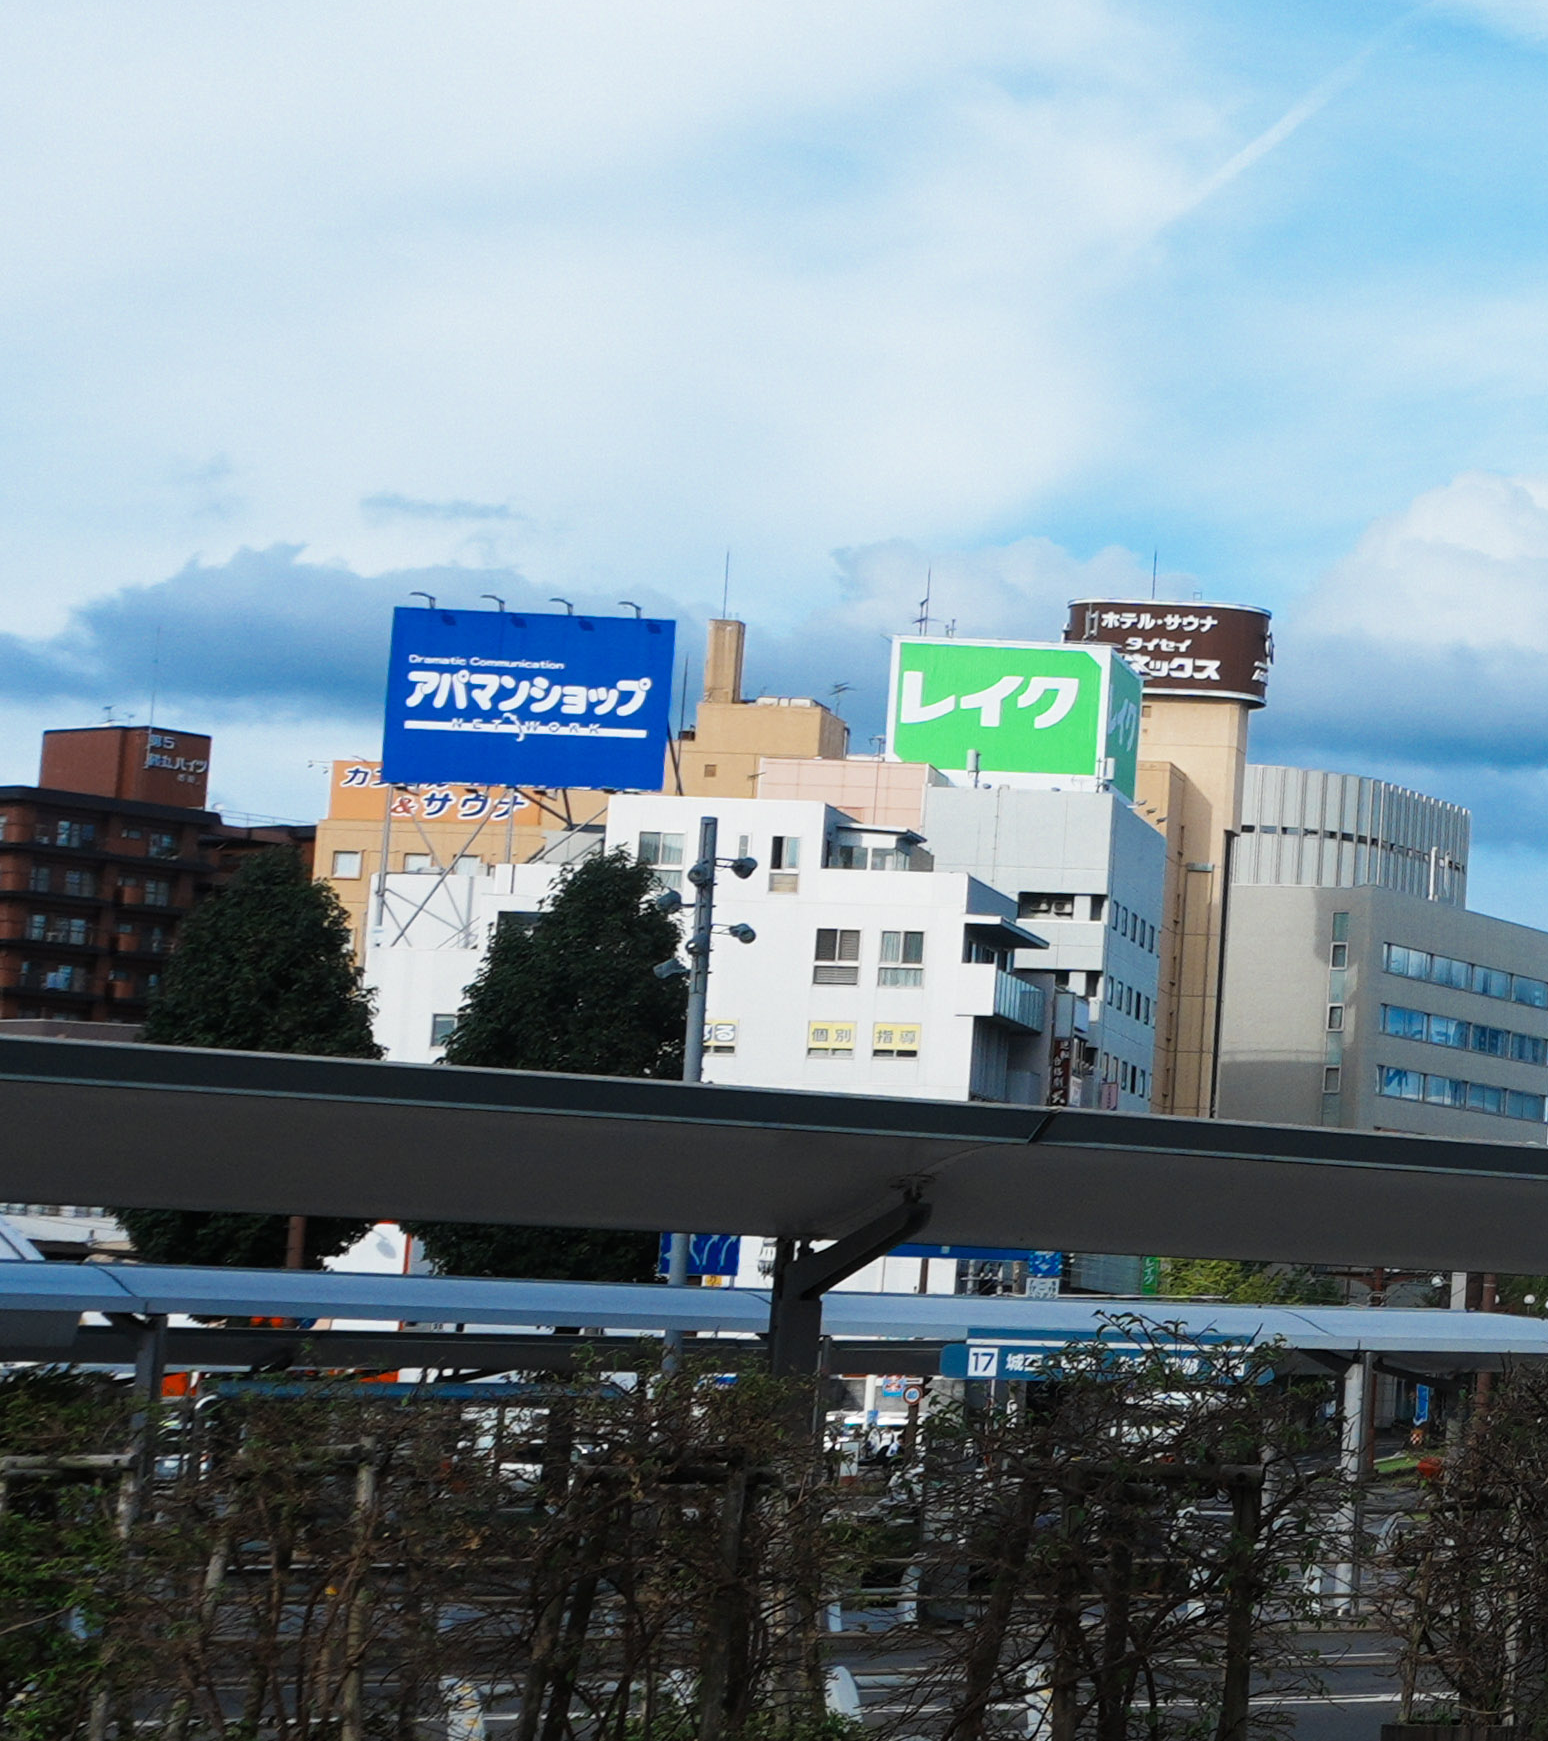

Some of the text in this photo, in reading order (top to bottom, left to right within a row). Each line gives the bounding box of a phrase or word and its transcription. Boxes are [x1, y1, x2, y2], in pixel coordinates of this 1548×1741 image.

[1100, 611, 1219, 633] ホテル・サウナ
[1124, 636, 1193, 653] タイセイ
[408, 653, 566, 670] Dramatic Communication
[1121, 653, 1221, 681] ネックス
[405, 668, 653, 717] アパマンショップ
[900, 671, 1079, 730] レイク
[421, 791, 530, 821] サウナ
[812, 1027, 916, 1044] 個別 指導
[970, 1352, 997, 1372] 17
